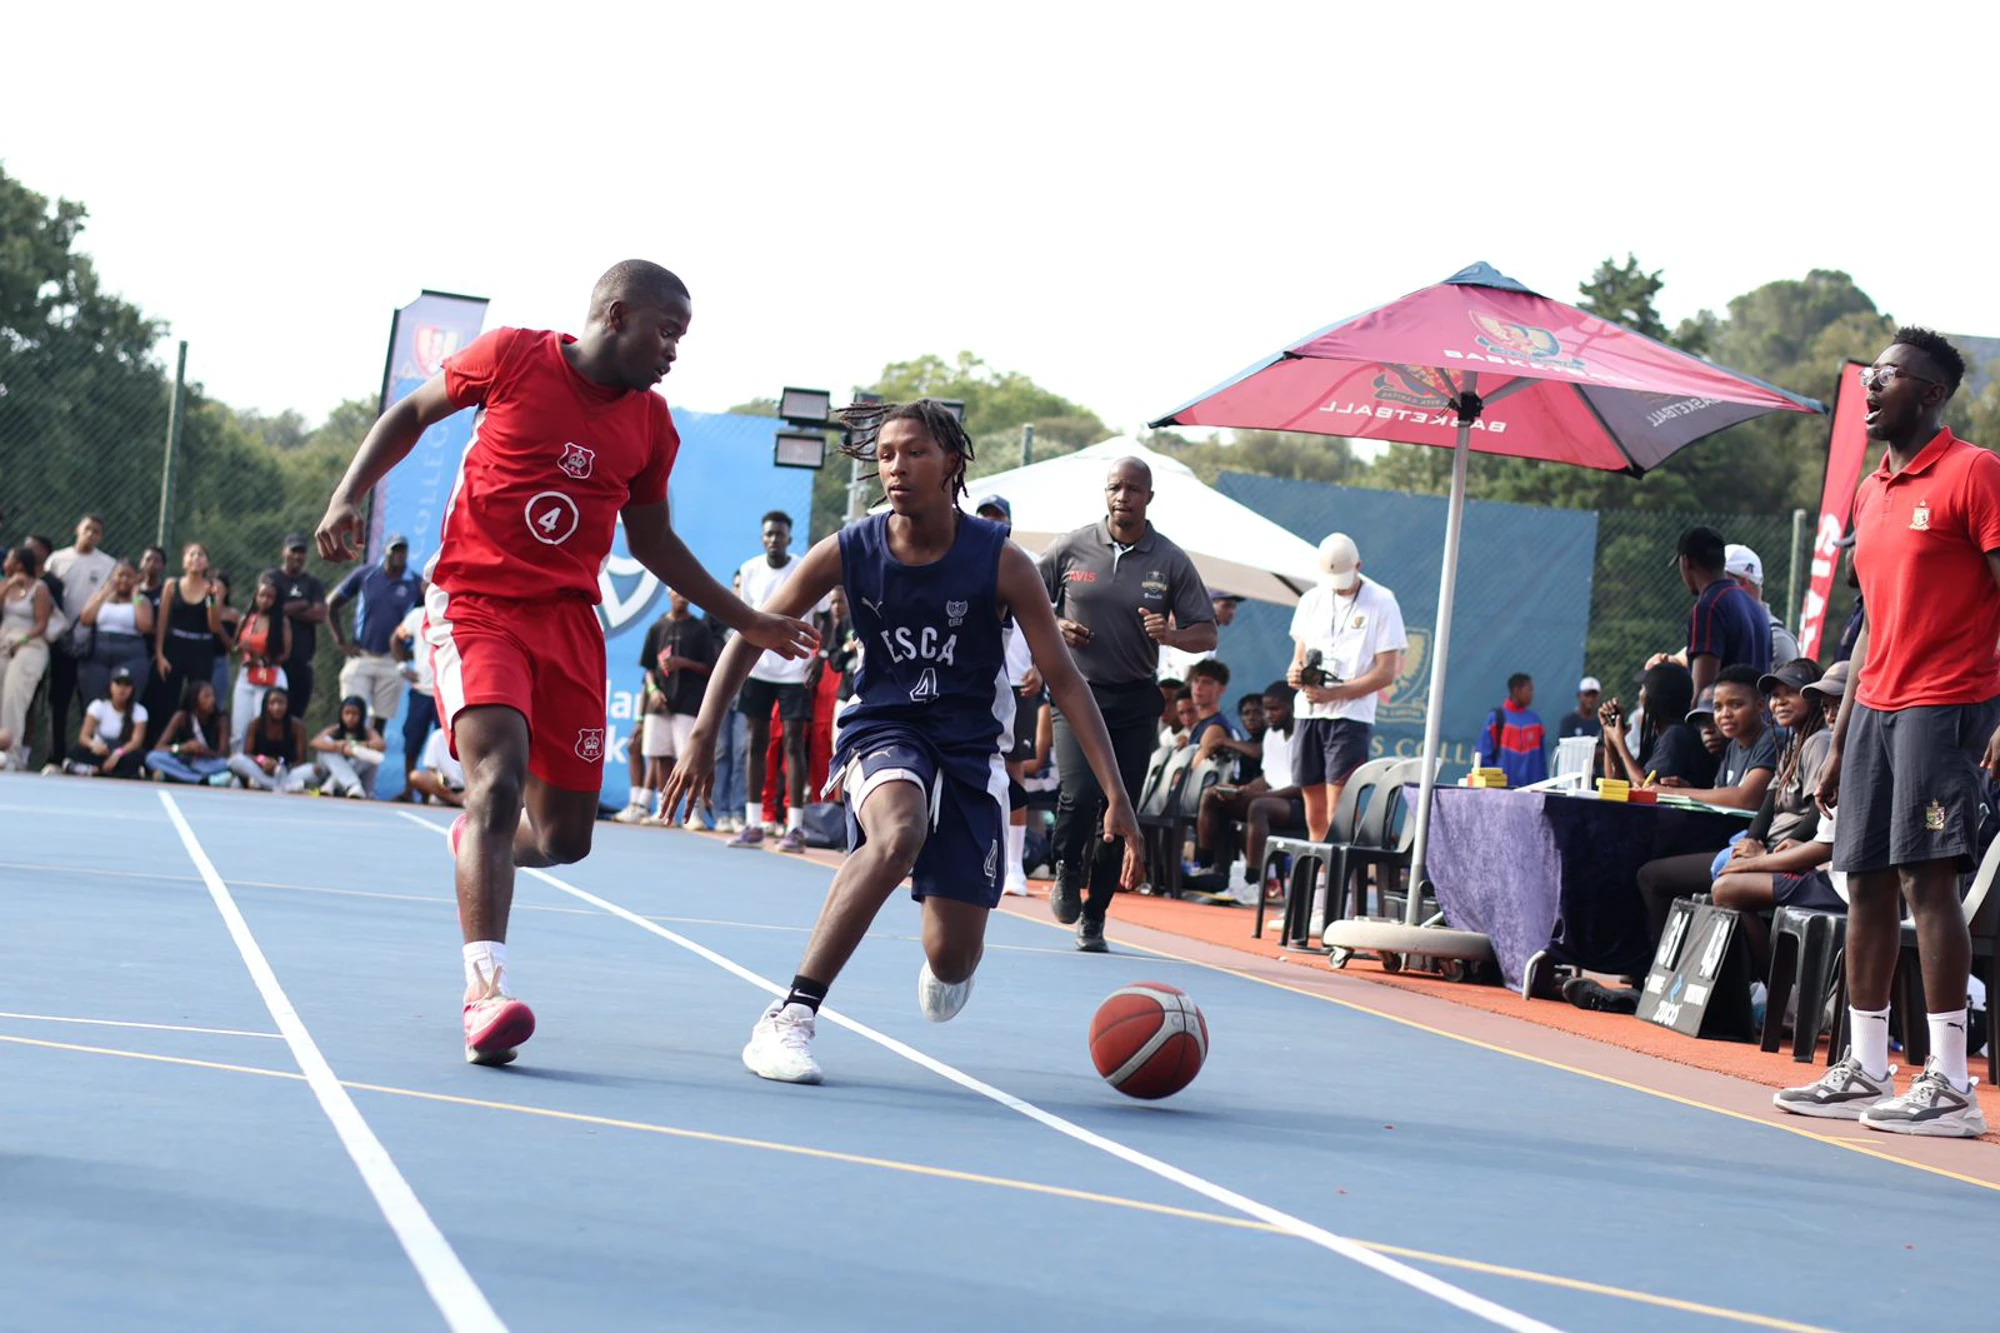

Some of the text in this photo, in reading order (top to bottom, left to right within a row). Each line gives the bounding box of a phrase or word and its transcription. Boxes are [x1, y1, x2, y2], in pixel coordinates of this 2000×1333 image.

[538, 507, 561, 533] 4
[1069, 569, 1098, 583] AVIS
[880, 627, 957, 667] ESCA
[909, 667, 940, 704] 4
[983, 838, 998, 888] 4
[1658, 911, 1690, 969] 31
